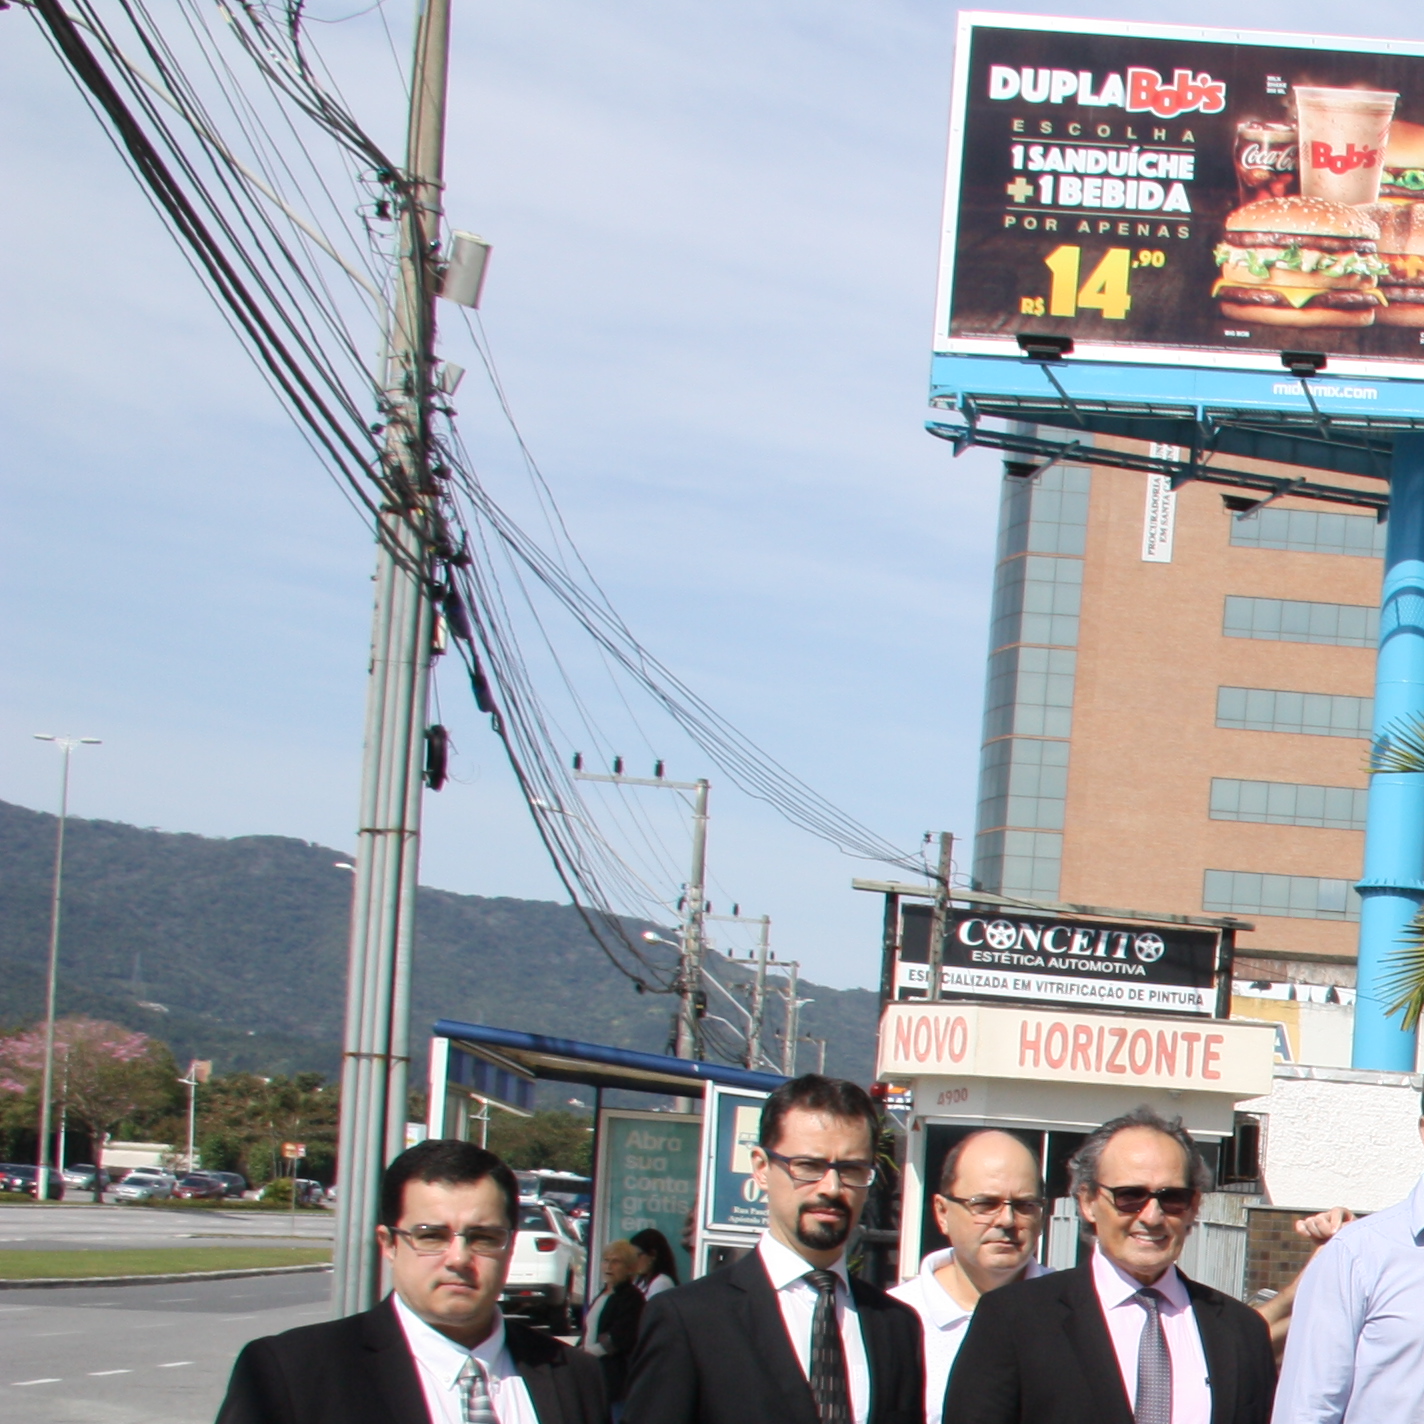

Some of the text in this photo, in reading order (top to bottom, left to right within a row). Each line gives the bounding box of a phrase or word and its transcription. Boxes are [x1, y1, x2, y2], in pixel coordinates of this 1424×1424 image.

[989, 65, 1226, 119] DUPLA Bob's
[1012, 119, 1195, 143] ESCOLHA
[1011, 145, 1196, 180] 1 SANDUÍCHE
[1311, 140, 1378, 175] Bob's
[1058, 176, 1192, 213] BEBIDA
[1004, 215, 1190, 239] POR APENAS
[1020, 296, 1045, 317] R$
[959, 918, 1165, 963] CONCEITO
[972, 950, 1146, 976] ESTÉTICA AUTOMOTIVA
[908, 969, 1204, 1006] ESCIALIZADA EM VITRIFICAÇÃO DE PINTURA
[894, 1015, 968, 1063] NOVO
[1019, 1020, 1224, 1080] HORIZONTE
[625, 1129, 682, 1151] Abra
[624, 1154, 667, 1171] sua
[623, 1175, 690, 1194] conta
